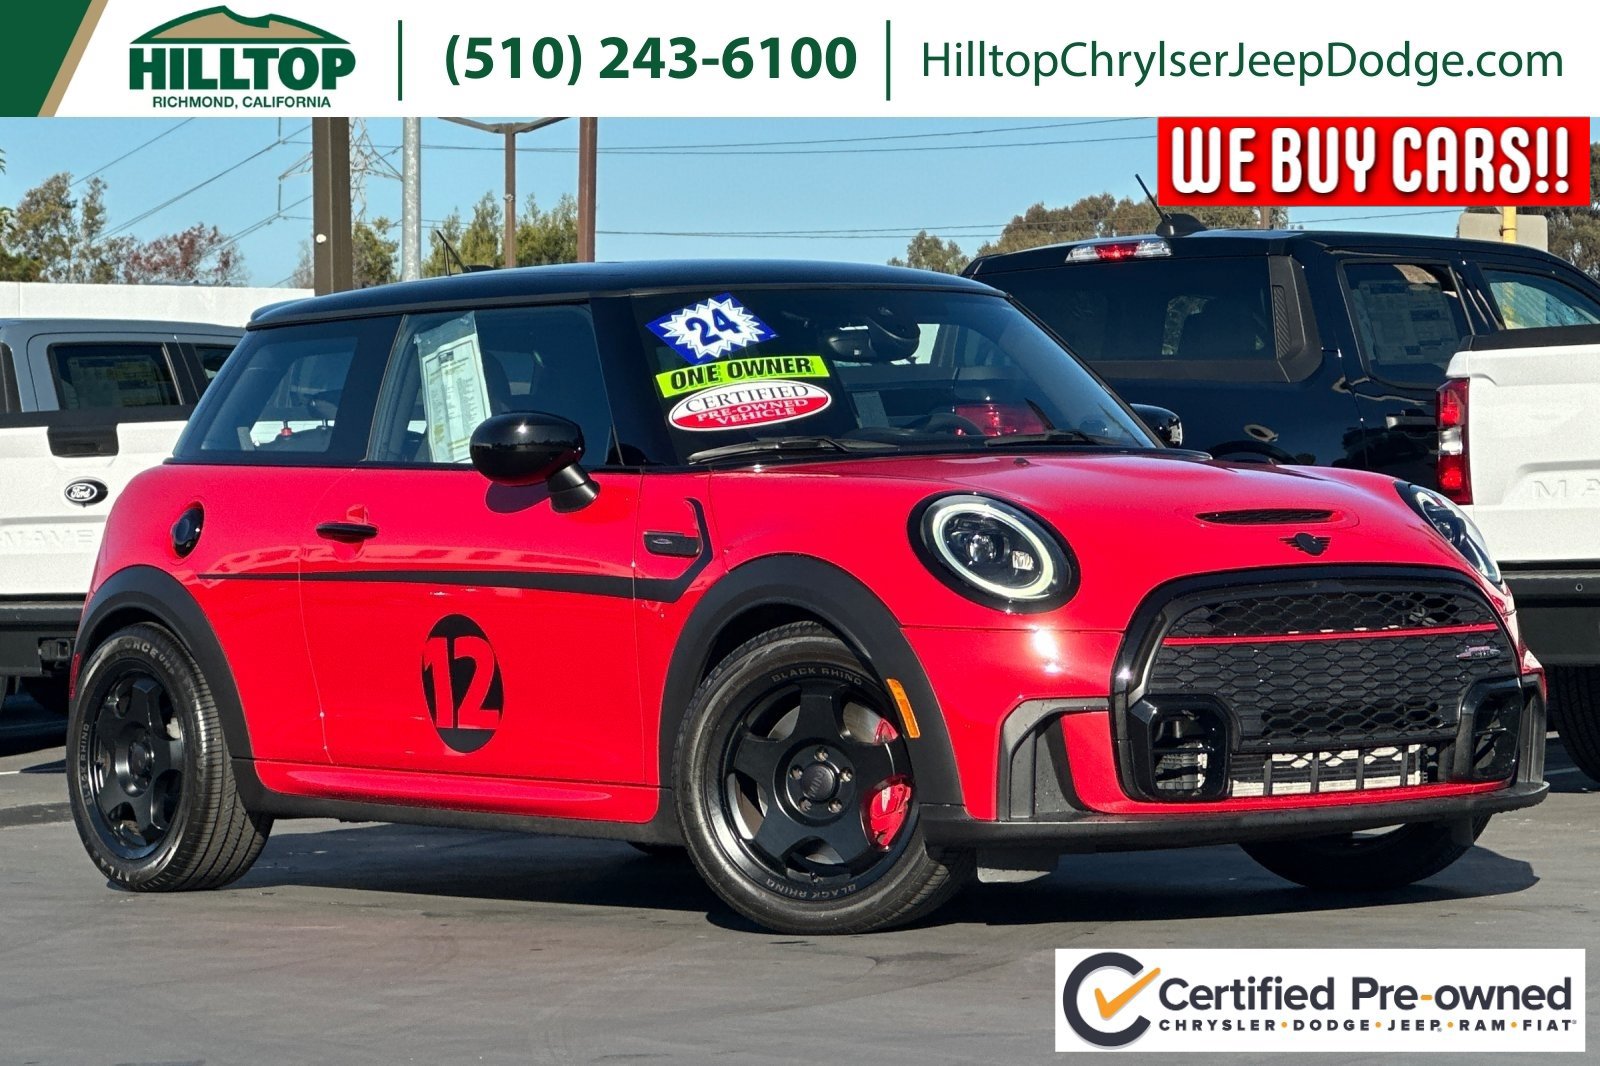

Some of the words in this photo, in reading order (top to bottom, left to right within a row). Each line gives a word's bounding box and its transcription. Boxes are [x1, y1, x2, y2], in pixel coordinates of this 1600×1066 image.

[685, 307, 744, 347] 24
[670, 363, 723, 390] ONE
[727, 357, 813, 379] OWNER
[685, 384, 809, 413] CERTIFIED
[695, 398, 809, 422] PRE-OWNED
[716, 407, 797, 425] VEHICLE
[422, 635, 500, 730] 12
[770, 667, 816, 683] BLACK
[820, 667, 863, 685] RHINO
[80, 723, 90, 761] RHINO
[765, 878, 807, 898] RHINO
[811, 883, 857, 899] BLACK
